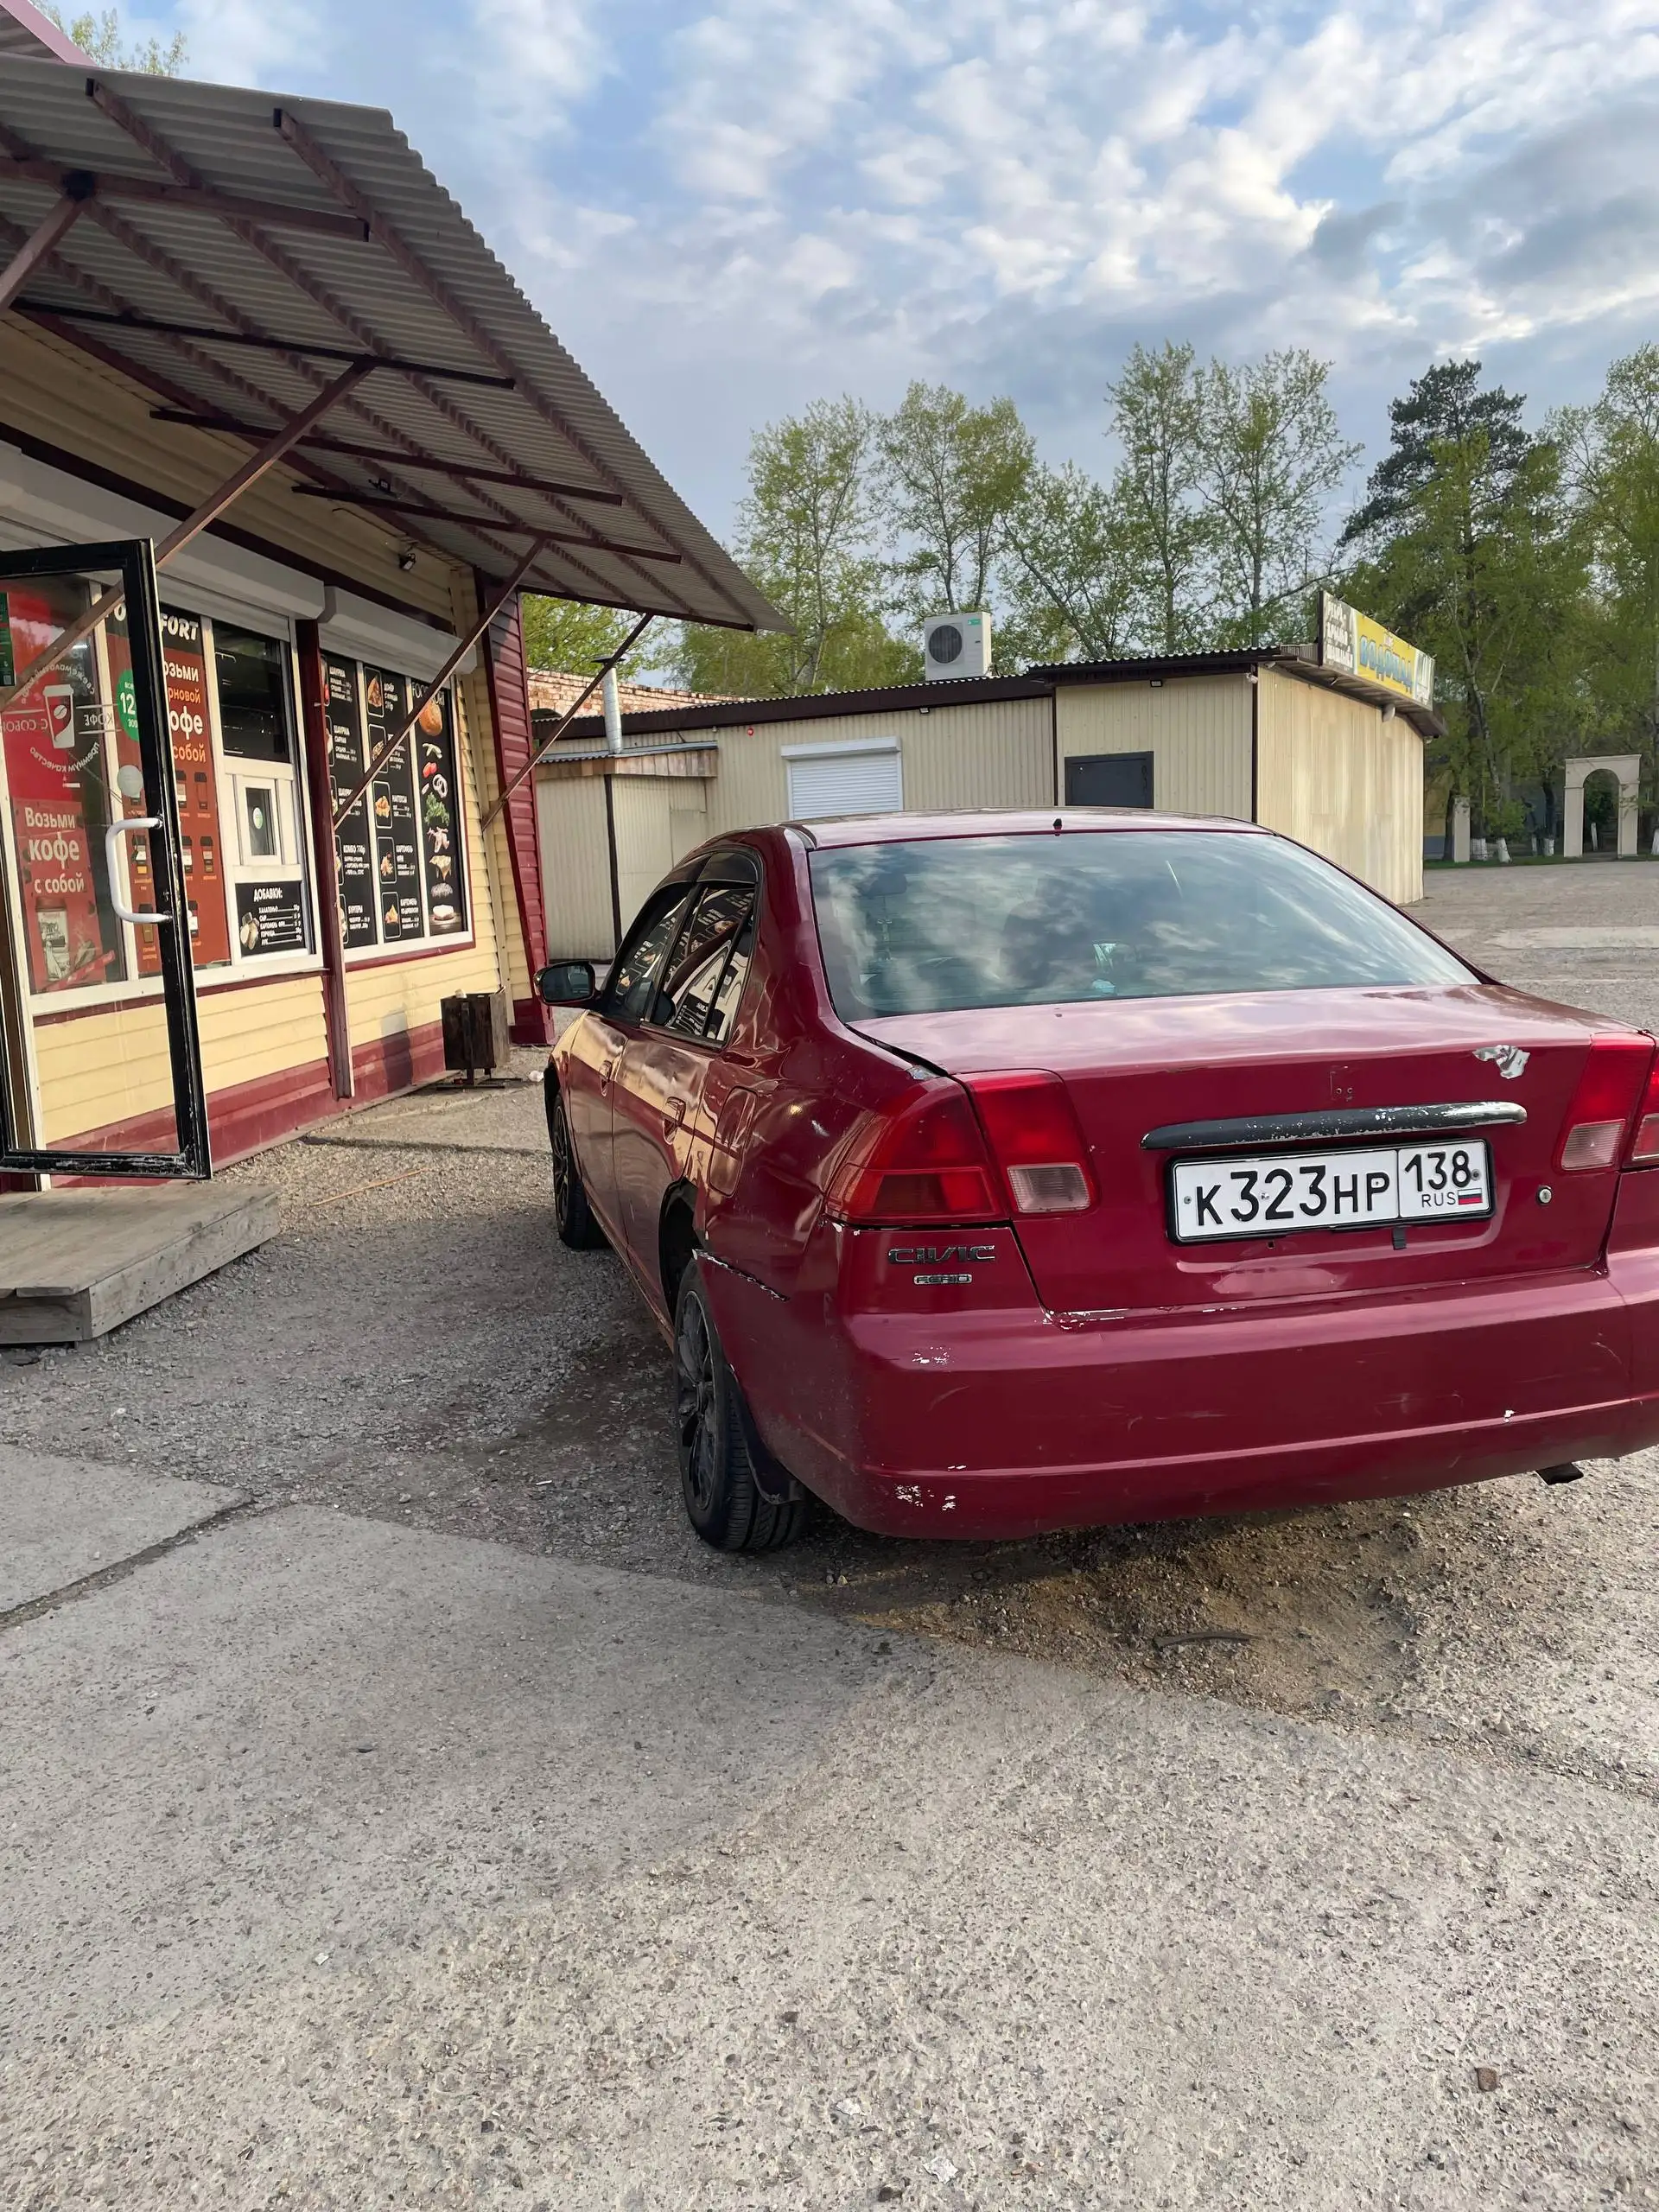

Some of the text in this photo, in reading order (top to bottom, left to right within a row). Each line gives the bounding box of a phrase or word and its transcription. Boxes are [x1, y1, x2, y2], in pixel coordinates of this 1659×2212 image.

[163, 661, 199, 682] озьми
[169, 705, 203, 741] офе
[24, 807, 76, 829] Возьми
[28, 831, 80, 869] кофе
[35, 873, 85, 893] с собой
[253, 887, 283, 902] ДОБАВКИ:
[1195, 1150, 1471, 1226] К323НР 138
[1421, 1192, 1457, 1208] RUS
[888, 1245, 995, 1264] CIVIC
